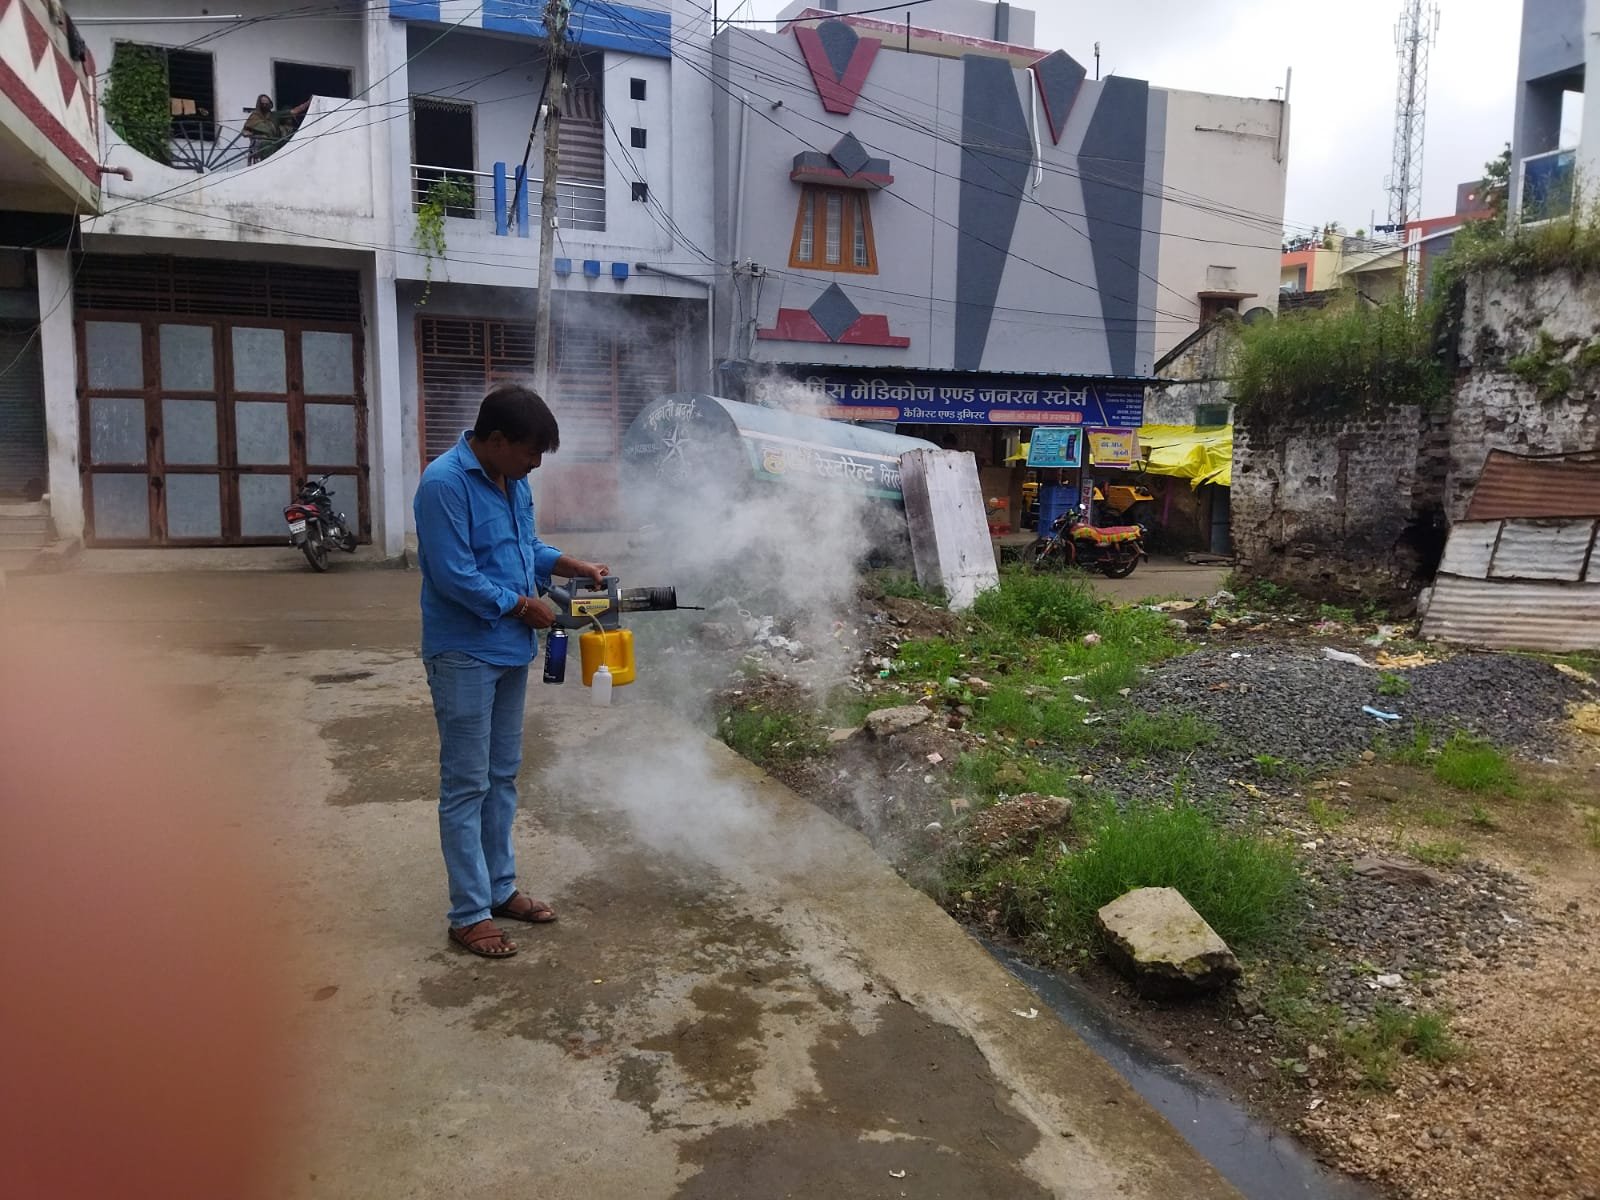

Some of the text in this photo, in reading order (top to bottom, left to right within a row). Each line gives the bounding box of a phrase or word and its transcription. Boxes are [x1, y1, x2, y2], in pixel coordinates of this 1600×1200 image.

[851, 378, 935, 401] मेडिकोज
[940, 387, 976, 405] एण्ड
[979, 388, 1039, 404] जनरल
[1042, 385, 1090, 406] स्टोर्स
[903, 408, 936, 418] कैमिस्ट
[938, 409, 955, 419] एण्ड
